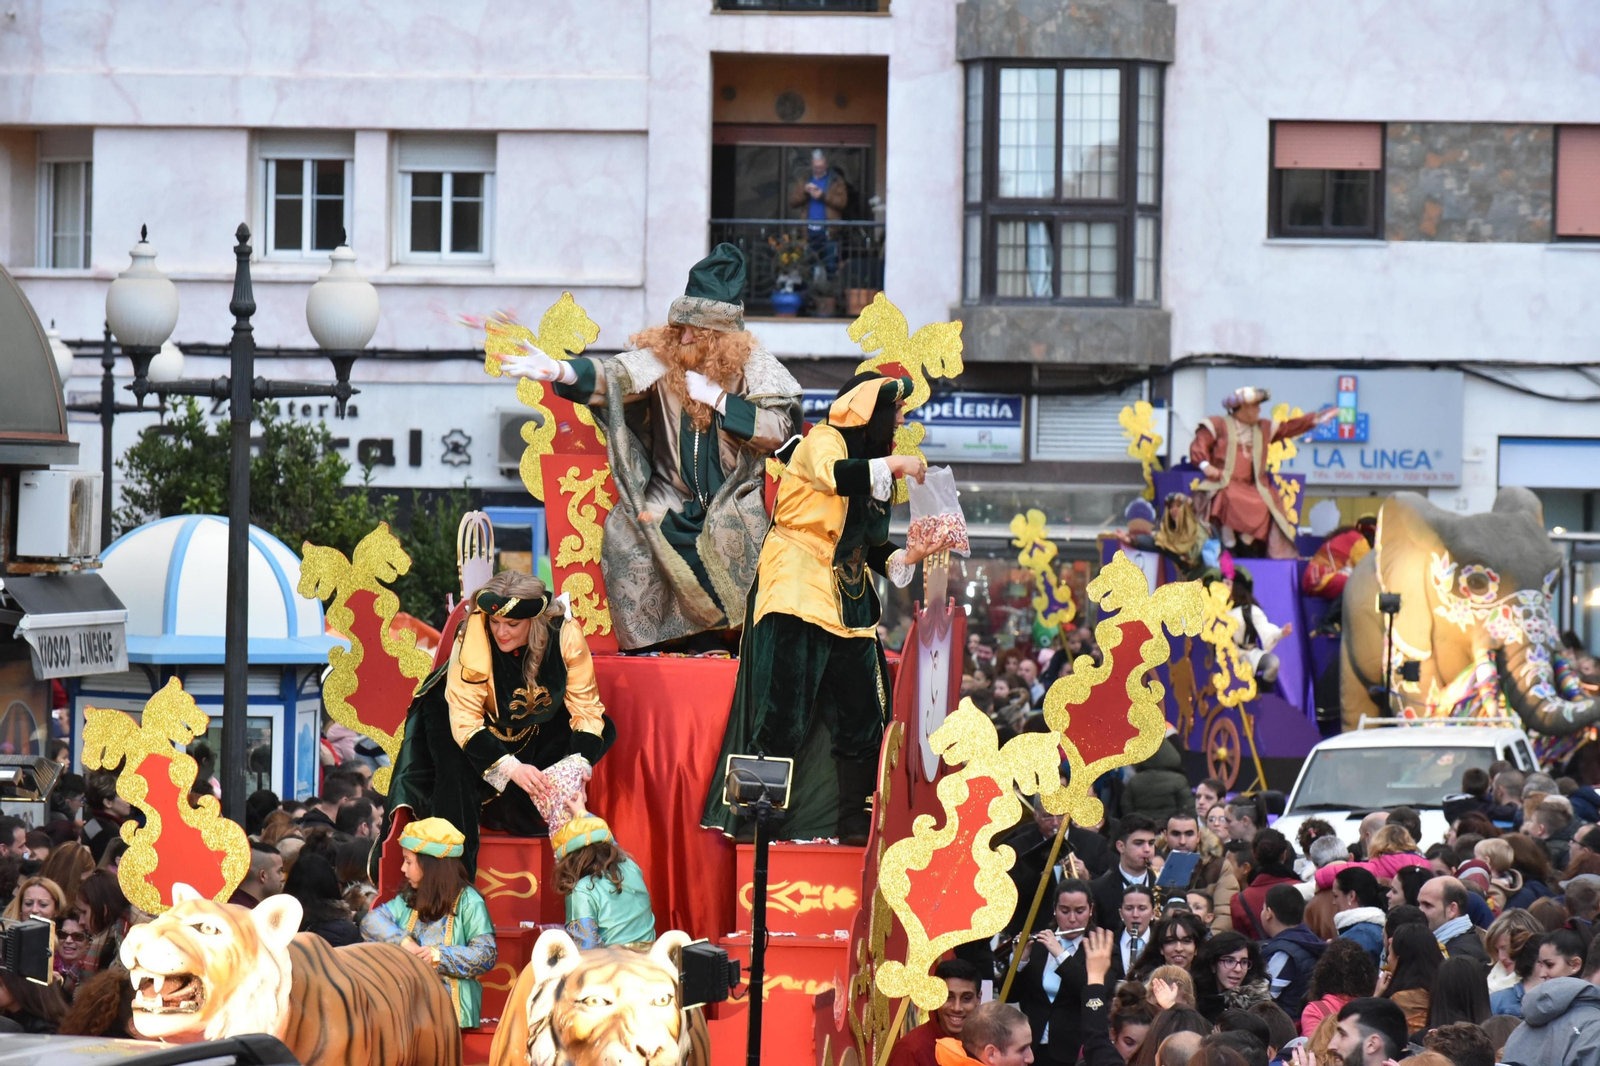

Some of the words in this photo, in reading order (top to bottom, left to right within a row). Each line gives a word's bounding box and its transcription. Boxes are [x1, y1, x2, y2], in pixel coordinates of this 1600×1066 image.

[1339, 376, 1355, 438] RNT
[1313, 448, 1346, 468] LA
[1360, 448, 1433, 470] LINEA
[38, 635, 71, 669] KIOSCO
[79, 631, 113, 666] LINENSE
